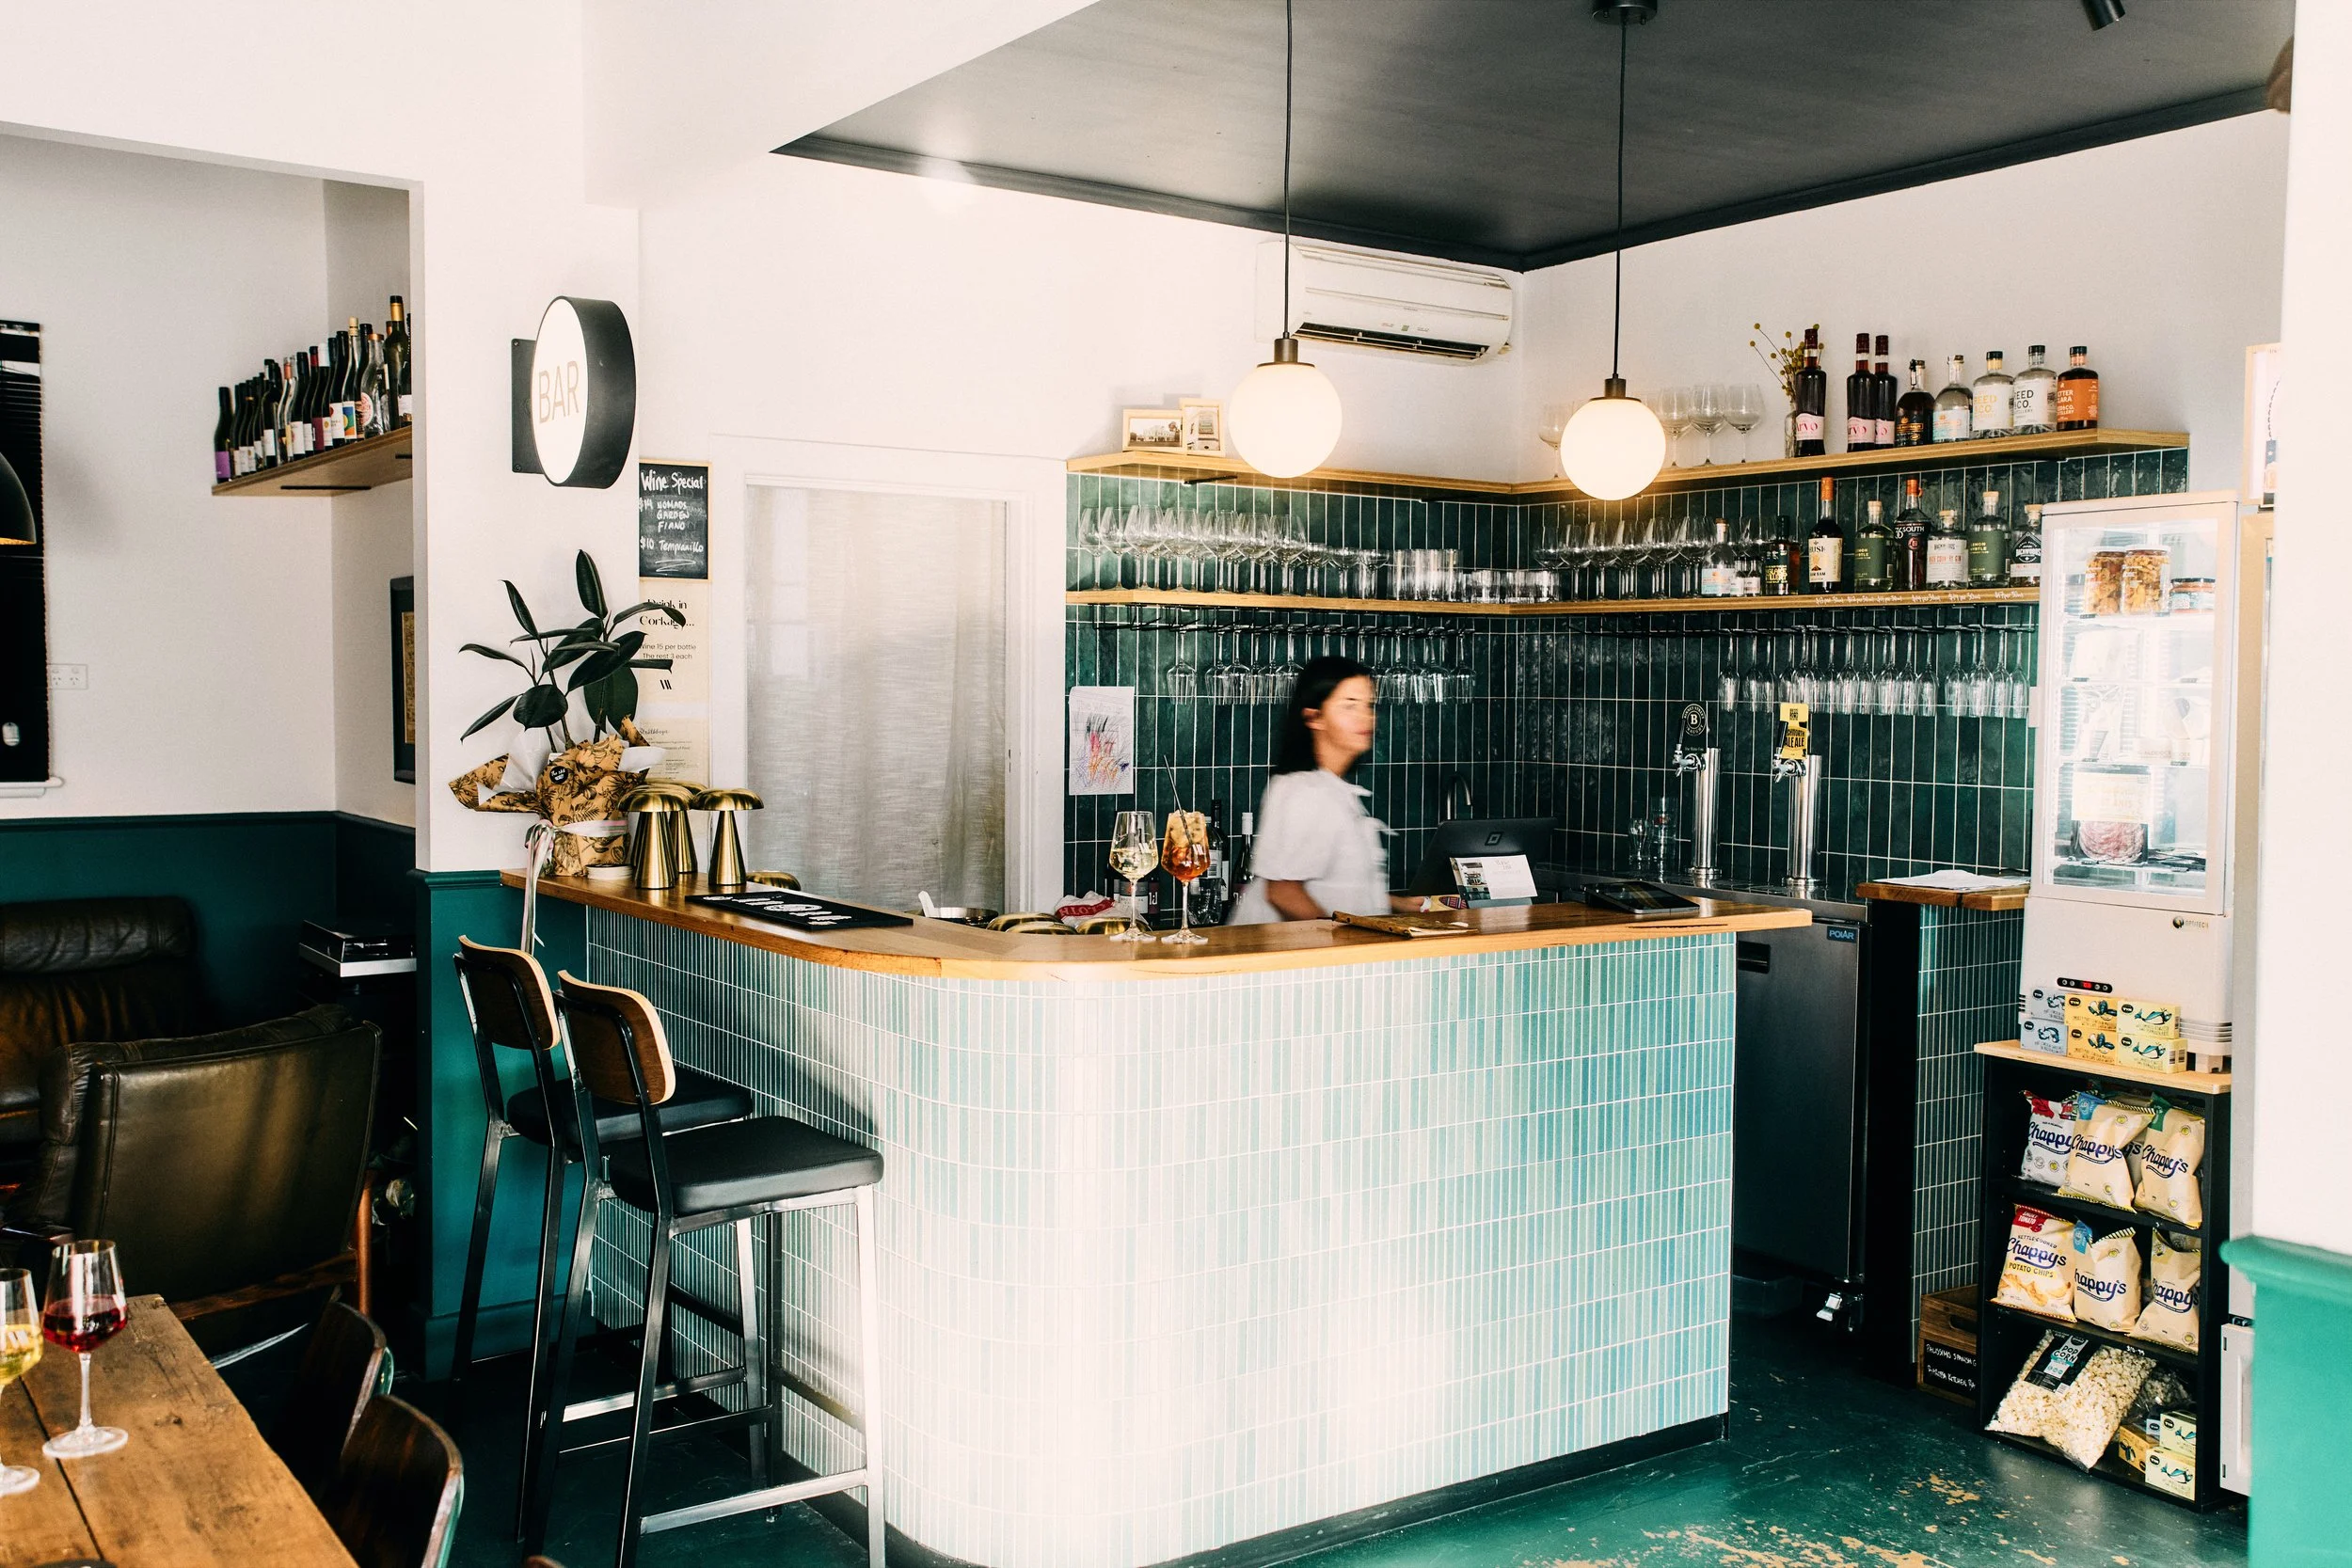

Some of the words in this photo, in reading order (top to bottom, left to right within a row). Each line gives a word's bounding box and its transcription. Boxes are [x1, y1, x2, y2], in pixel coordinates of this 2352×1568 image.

[538, 359, 580, 424] BAR
[641, 469, 669, 491] Wine
[672, 472, 704, 495] Special
[678, 600, 688, 610] in
[1691, 714, 1698, 724] B
[1795, 737, 1804, 748] ALE
[2009, 1262, 2031, 1273] POTATO
[2033, 1268, 2054, 1278] CHIPS
[2074, 1268, 2126, 1297] happy's
[2061, 1345, 2078, 1354] POP
[2053, 1351, 2076, 1362] CORN
